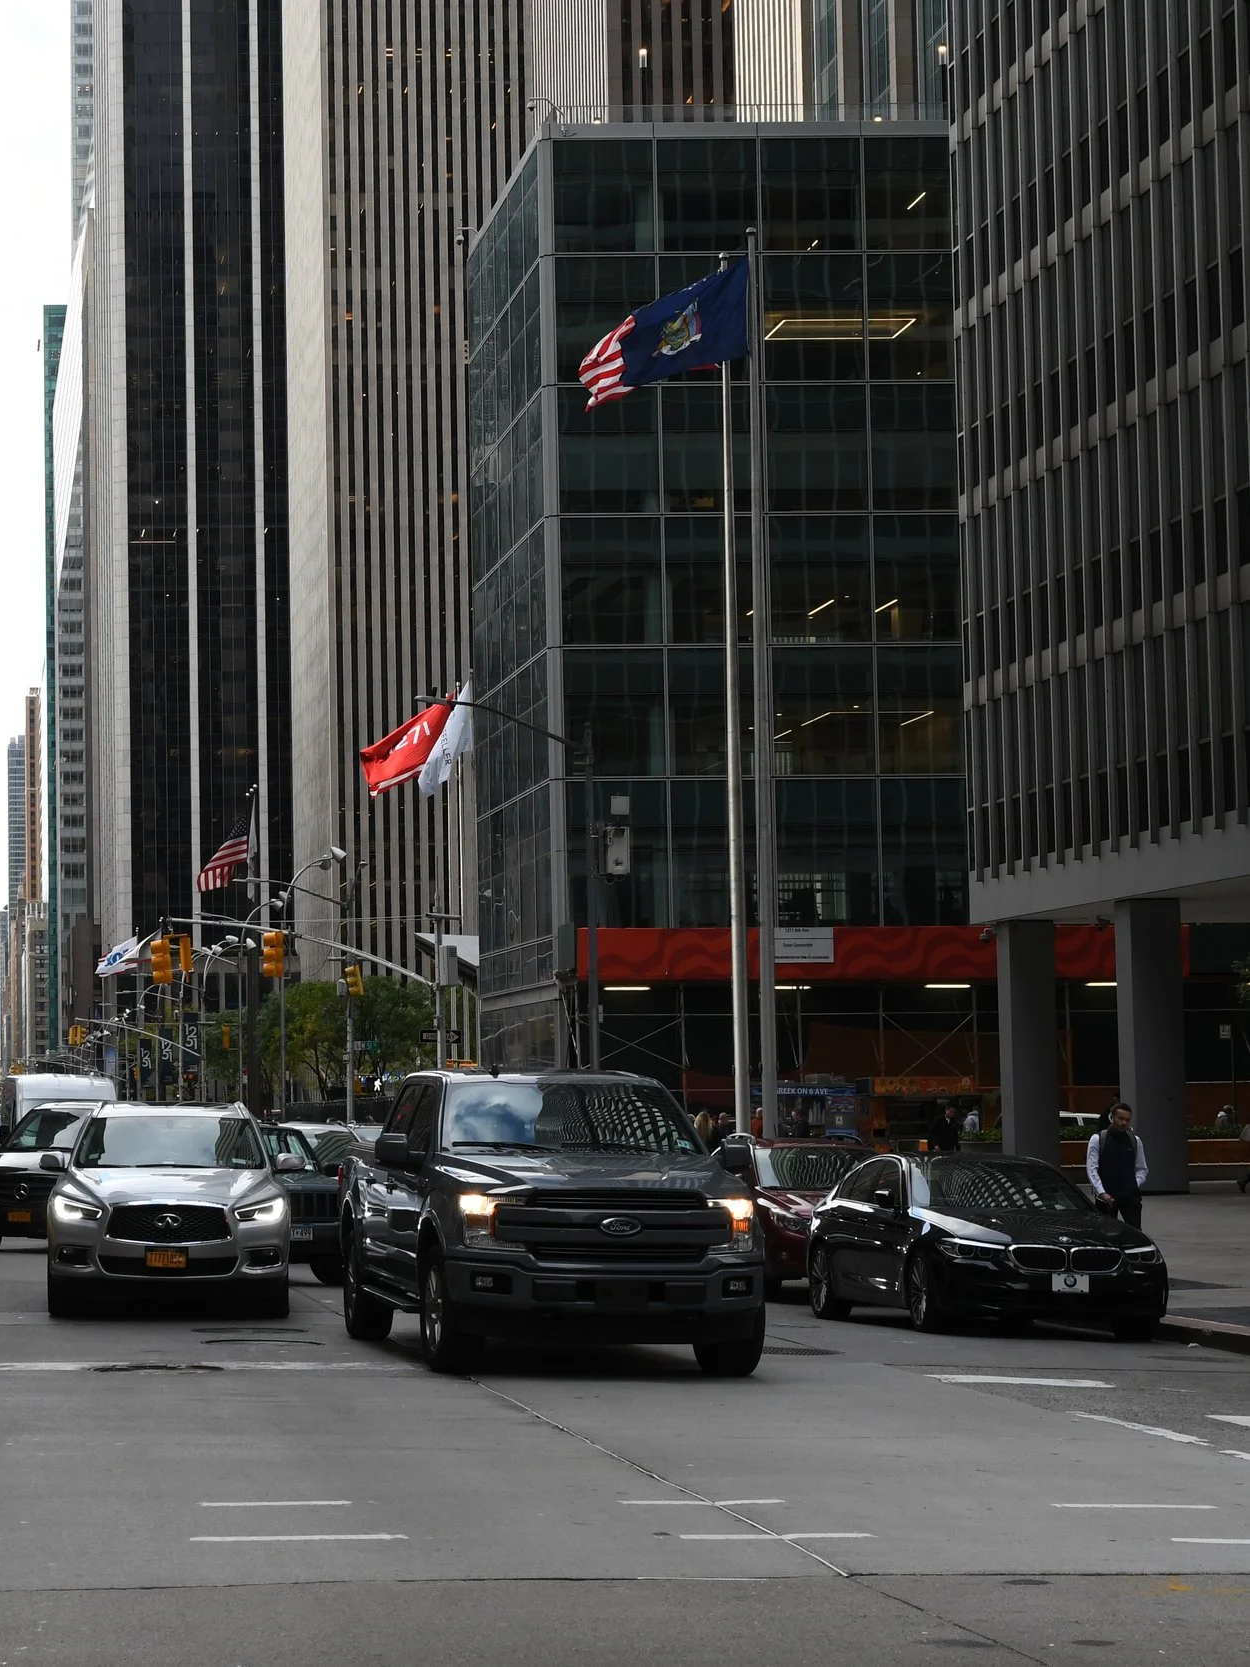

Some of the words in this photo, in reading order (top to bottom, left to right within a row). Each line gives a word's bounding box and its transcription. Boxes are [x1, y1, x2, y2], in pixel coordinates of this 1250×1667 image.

[389, 721, 431, 754] 271
[184, 1023, 198, 1038] 12
[185, 1036, 198, 1050] 51
[141, 1048, 151, 1060] 12
[161, 1050, 173, 1063] 51
[141, 1058, 152, 1069] 51
[797, 1087, 808, 1095] ON
[809, 1087, 814, 1095] 6
[814, 1087, 829, 1095] AVE
[609, 1220, 633, 1231] Ford
